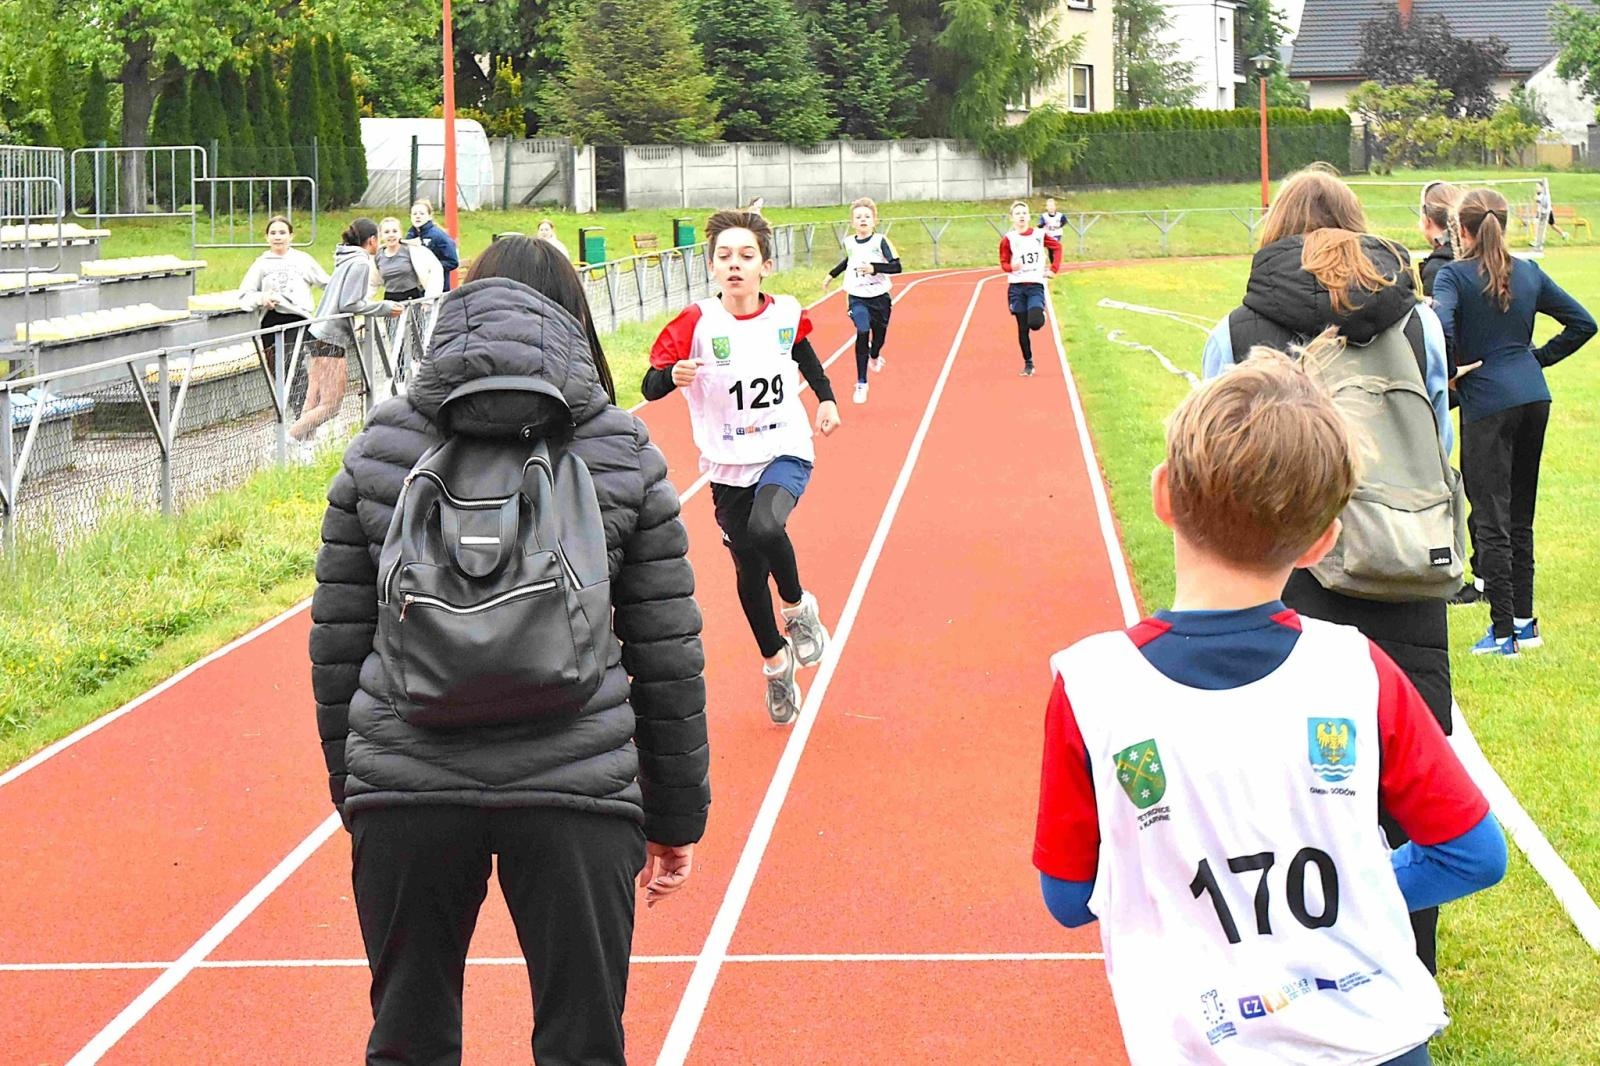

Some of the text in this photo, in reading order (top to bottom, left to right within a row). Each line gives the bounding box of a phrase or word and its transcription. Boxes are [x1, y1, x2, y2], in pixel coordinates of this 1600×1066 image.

[1020, 252, 1039, 265] 137
[728, 373, 784, 411] 129
[1189, 847, 1340, 944] 170
[1242, 999, 1262, 1015] CZ
